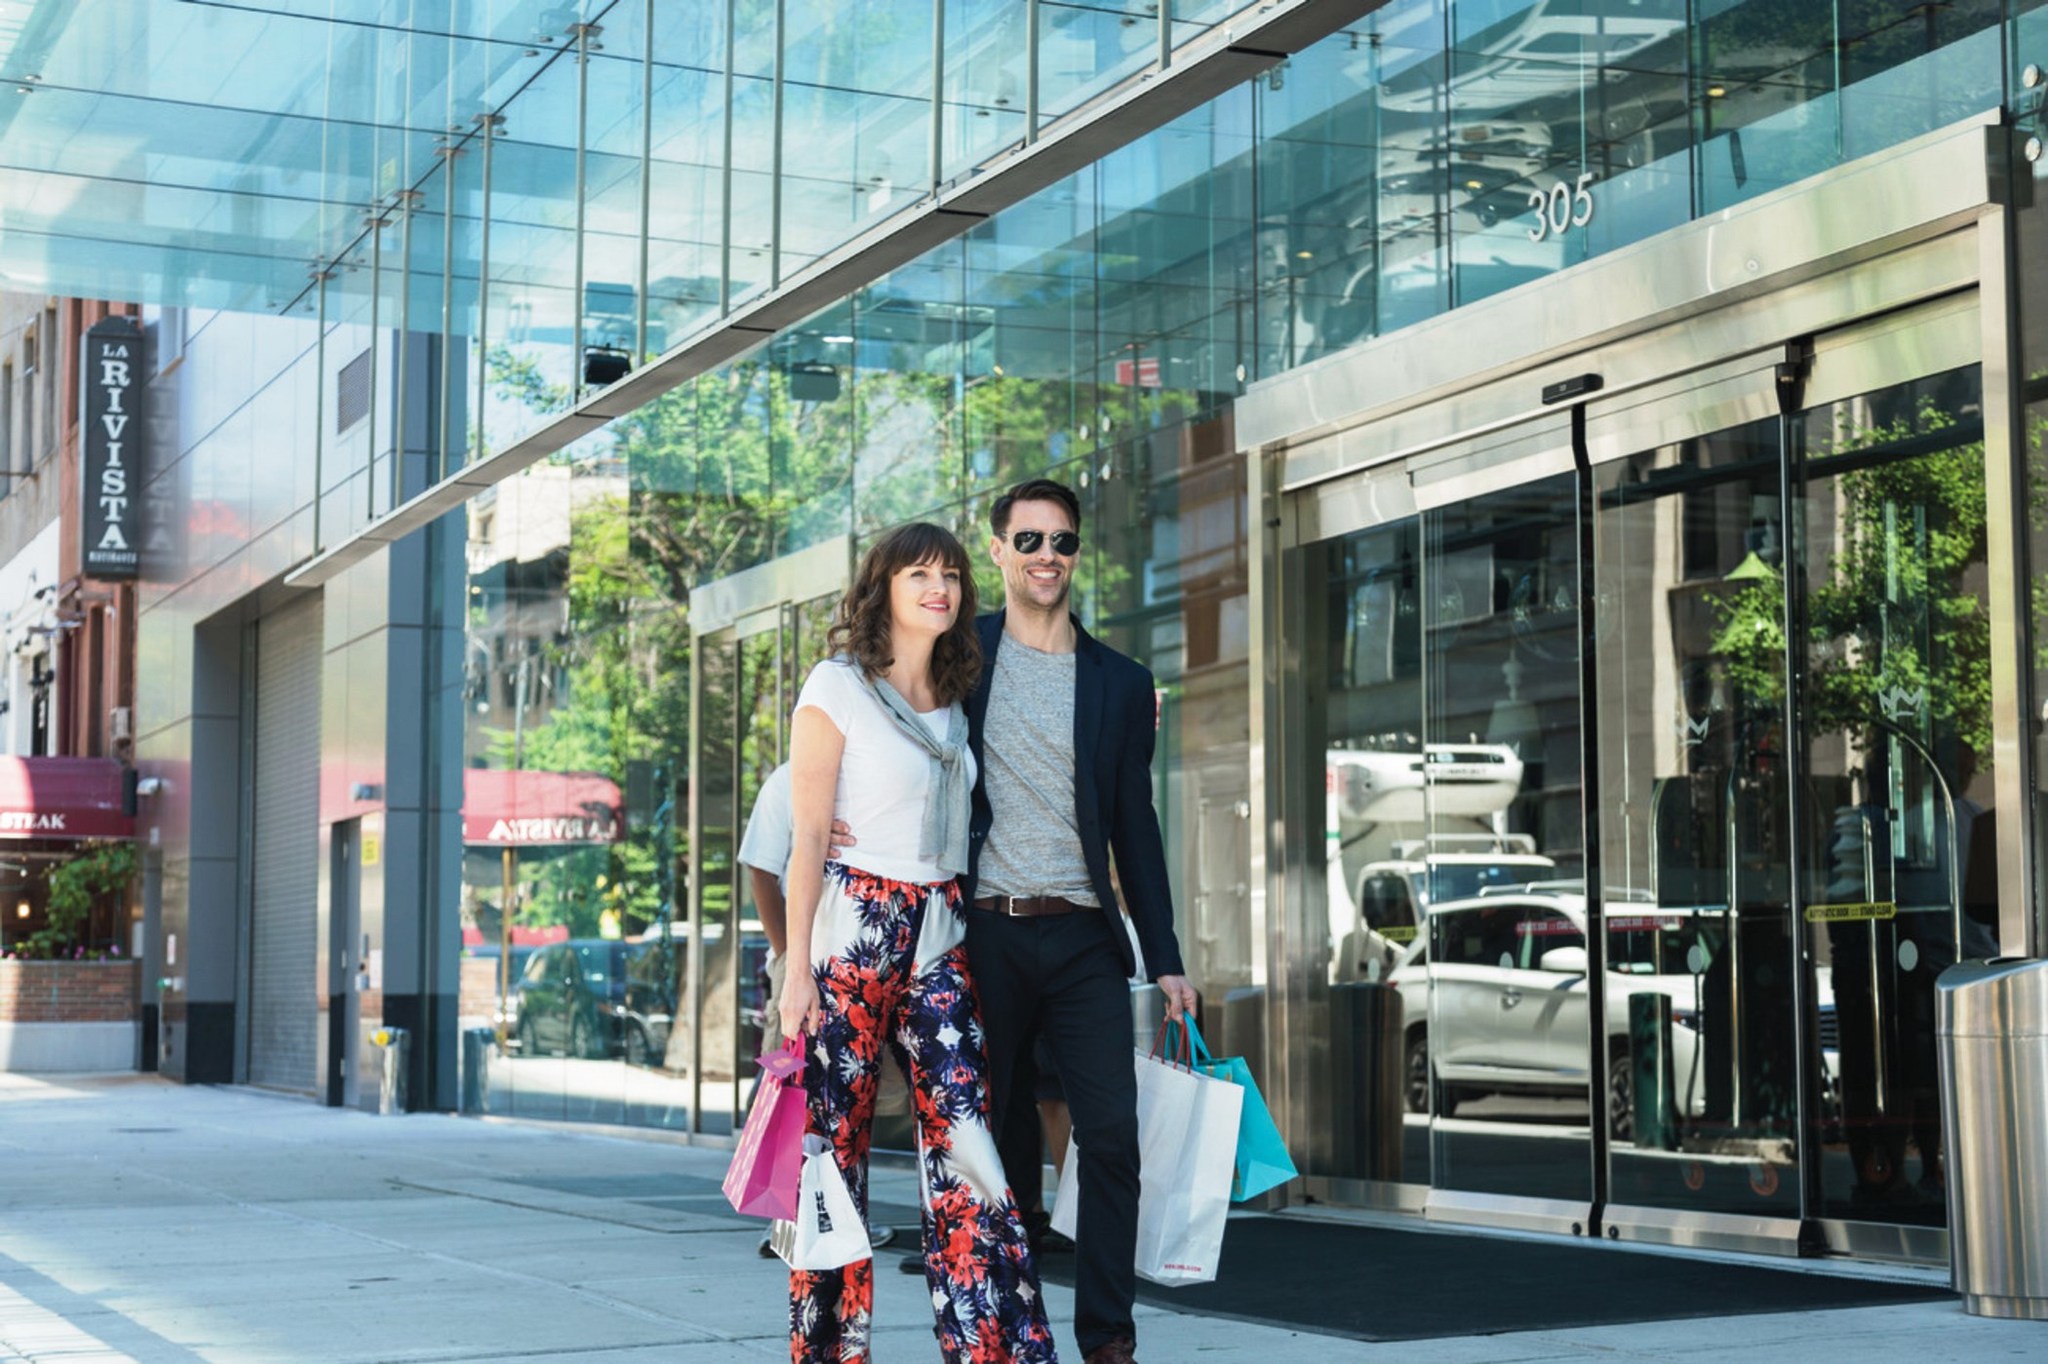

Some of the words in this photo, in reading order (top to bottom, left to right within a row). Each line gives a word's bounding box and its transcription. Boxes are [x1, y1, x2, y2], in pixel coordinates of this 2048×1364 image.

[1528, 172, 1592, 242] 305
[103, 344, 128, 357] LA
[98, 361, 130, 549] RIVISTA
